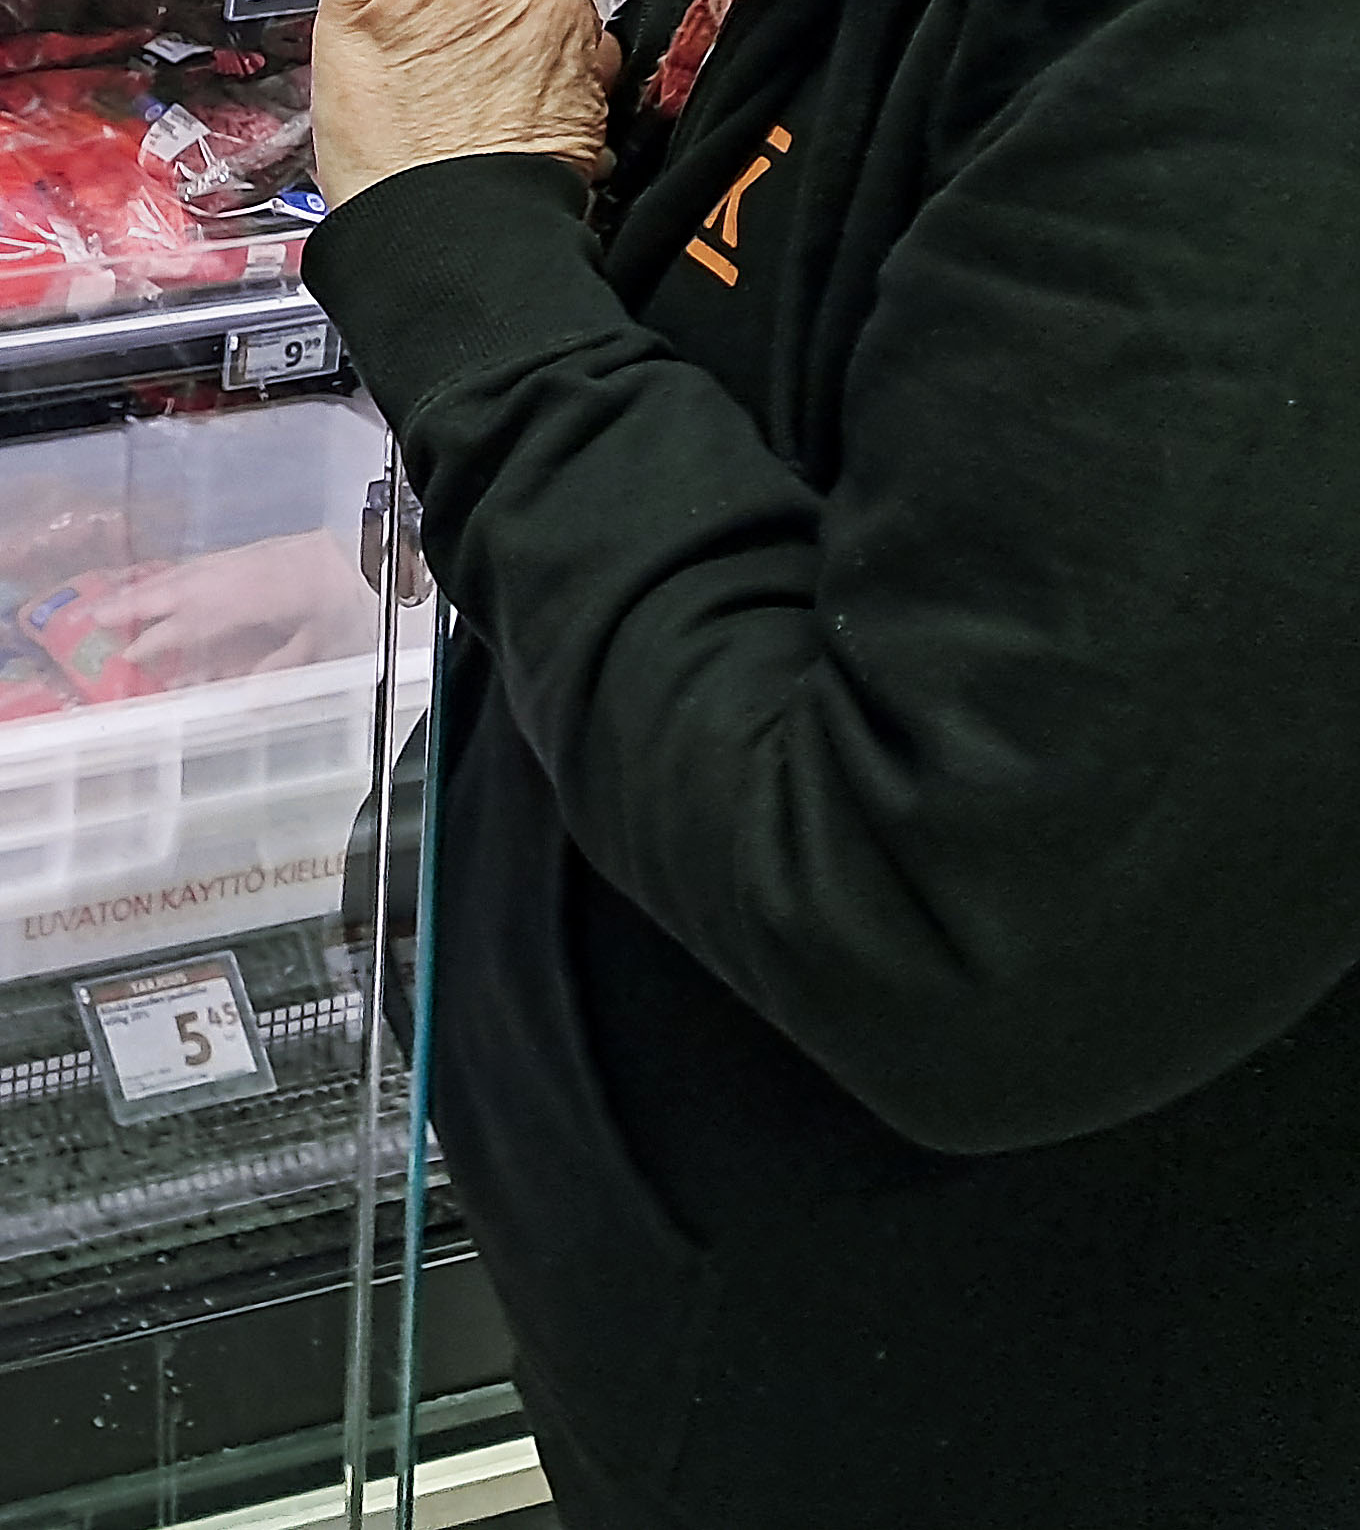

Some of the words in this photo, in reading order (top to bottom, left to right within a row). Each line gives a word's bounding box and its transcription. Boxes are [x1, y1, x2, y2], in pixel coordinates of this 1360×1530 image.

[284, 340, 305, 368] 9
[22, 892, 154, 941] LUVATON
[174, 1010, 212, 1067] 5
[206, 1001, 238, 1028] 45
